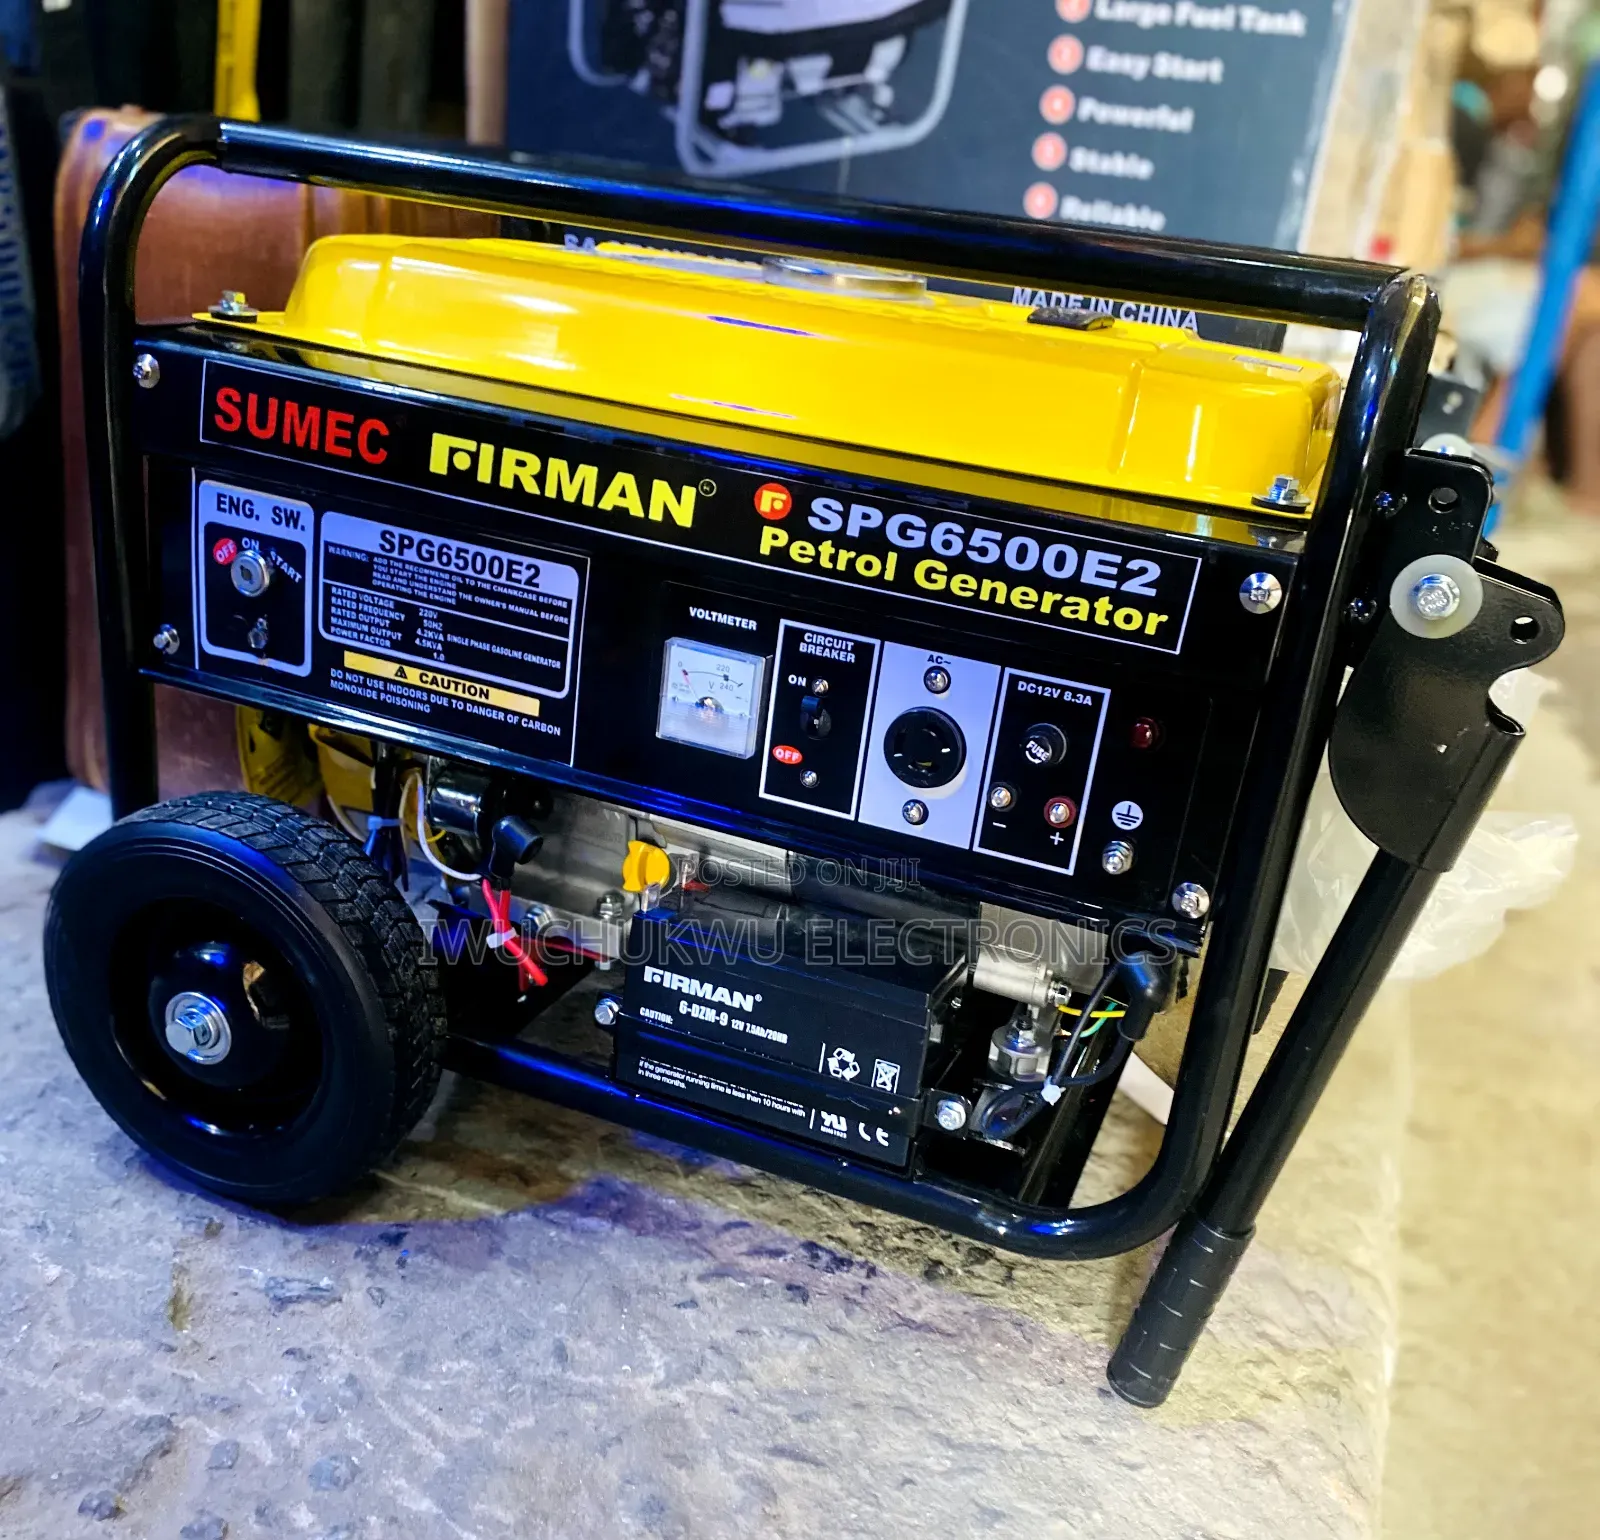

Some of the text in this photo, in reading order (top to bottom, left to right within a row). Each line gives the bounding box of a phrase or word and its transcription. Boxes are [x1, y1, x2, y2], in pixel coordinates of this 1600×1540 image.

[1088, 297, 1113, 317] IN
[1119, 302, 1198, 332] CHINA
[214, 387, 696, 528] SUMEC FIRMAN
[216, 493, 305, 531] ENG. SW.
[215, 541, 236, 564] OFF
[241, 537, 260, 551] ON
[807, 496, 1162, 597] SPG6500E2
[378, 529, 541, 588] SPG6500E2
[373, 564, 457, 589] YOU START THE ENGINE
[389, 560, 403, 569] THE
[465, 578, 475, 586] TO
[477, 581, 492, 590] THE
[538, 596, 568, 608] BEFORE
[759, 526, 1169, 636] Petrol Generator
[331, 586, 395, 609] RATED VOLTAGE
[372, 579, 457, 605] OPERATING THE ENGINE
[392, 576, 408, 585] AND
[409, 580, 457, 597] UNDERSTAND
[458, 592, 473, 602] THE
[474, 596, 507, 610] OWNER'S
[508, 604, 538, 617] MANUAL
[540, 612, 569, 624] BEFORE
[331, 596, 405, 621] RATED FREQUENCY
[331, 606, 390, 628] RATED OUTPUT
[419, 608, 438, 619] 220V
[689, 606, 758, 631] VOLTMETER
[330, 616, 402, 640] MAXIMUM OUTPUT
[330, 626, 391, 648] POWER FACTOR
[423, 619, 443, 631] 50HZ
[416, 628, 561, 669] 4.2KVA SINGLE PHASE GASOLINE GENERATOR
[799, 642, 856, 663] BREAKER
[803, 632, 854, 652] CIRCUIT
[418, 672, 490, 700] CAUTION
[788, 674, 807, 687] ON
[330, 679, 431, 713] MONOXIDE POISONING
[330, 668, 561, 736] DO NOT USE INDOORS DUE TO DANGER OF CARBON
[1018, 681, 1092, 706] DC12V 8.3A
[775, 749, 799, 762] OFF
[1026, 740, 1051, 762] FUSE
[639, 1006, 673, 1025] CAUTION:
[678, 1000, 729, 1026] 6-DZM-9
[731, 1018, 745, 1032] 12V
[645, 1070, 661, 1081] three
[644, 1061, 654, 1071] the
[654, 1066, 685, 1080] generator
[685, 1075, 710, 1089] running
[710, 1082, 725, 1093] time
[732, 1088, 746, 1099] less
[746, 1093, 761, 1104] than
[763, 1098, 771, 1107] 10
[771, 1101, 791, 1113] hours
[791, 1108, 806, 1118] with
